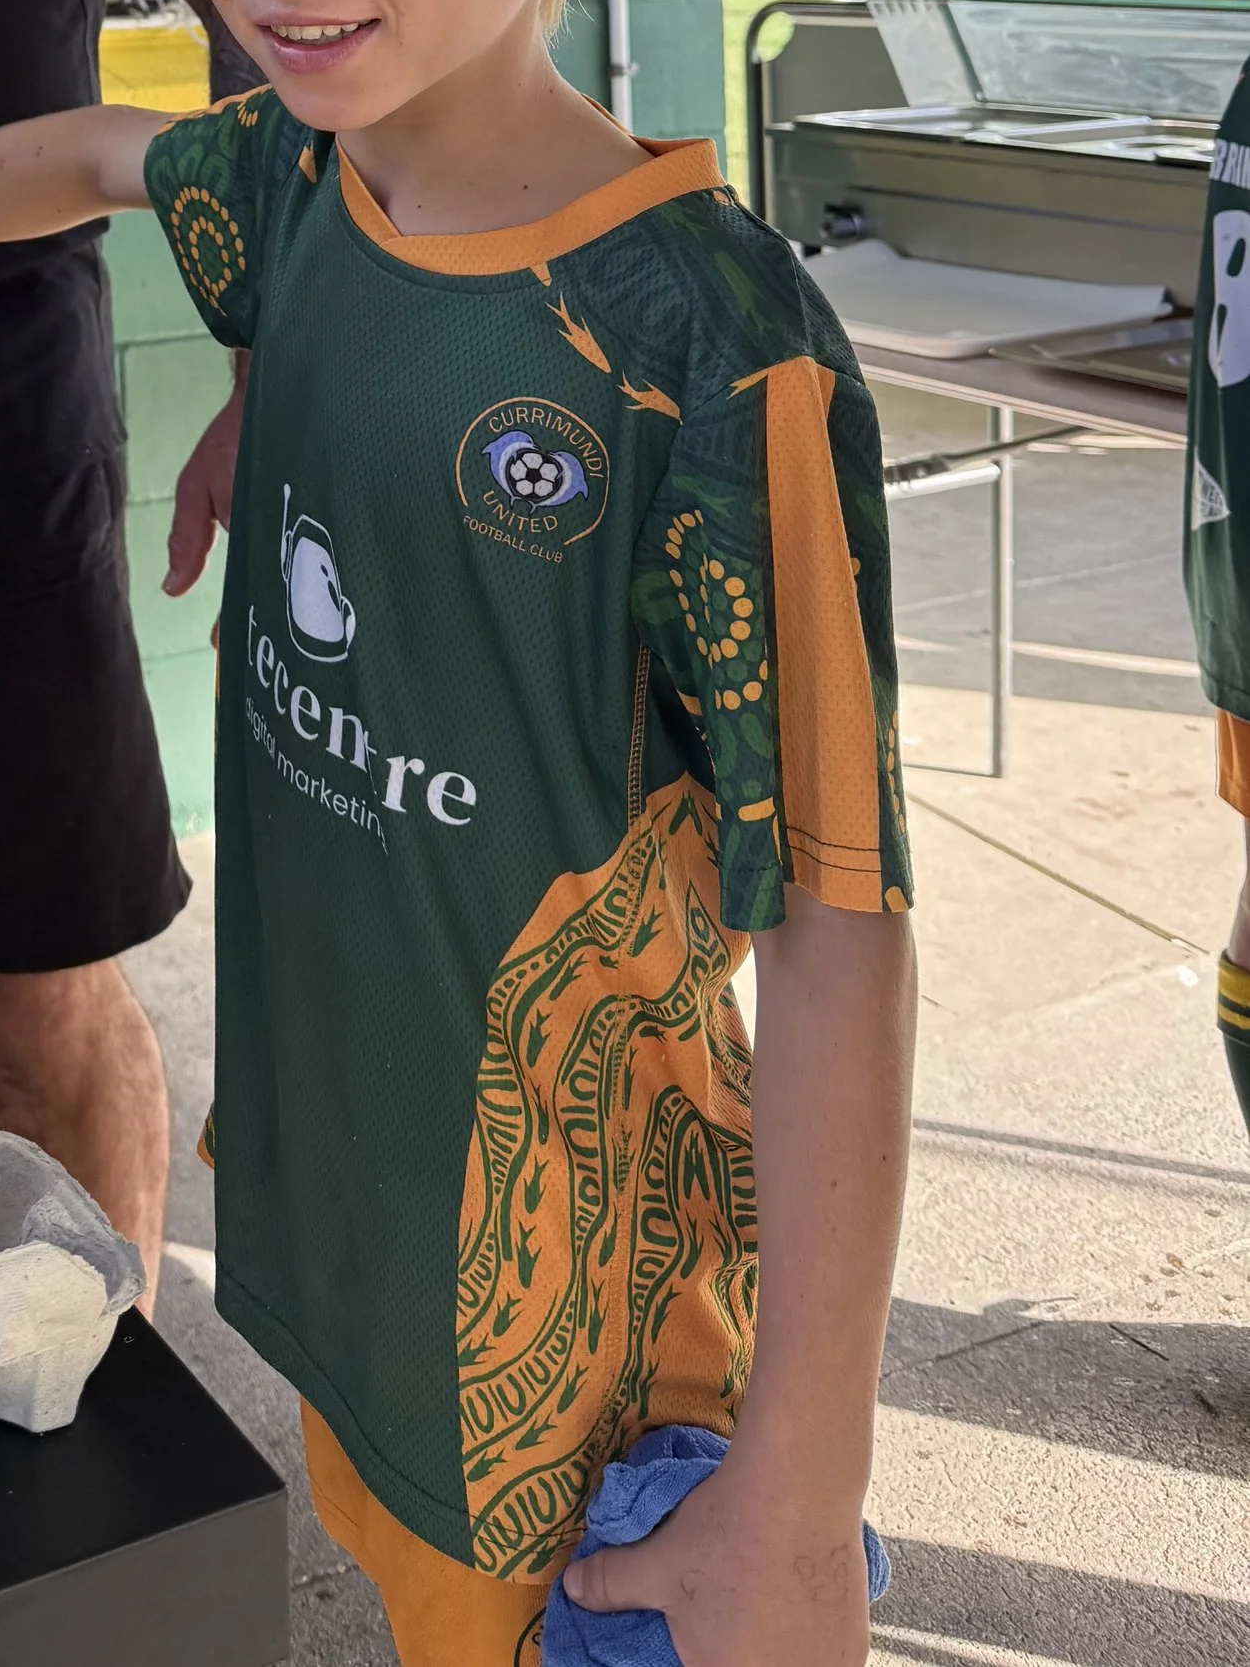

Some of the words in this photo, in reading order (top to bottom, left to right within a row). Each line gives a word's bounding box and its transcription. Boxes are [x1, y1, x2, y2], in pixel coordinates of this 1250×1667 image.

[488, 407, 604, 479] CURRIMUNDI
[463, 515, 526, 552] FOOTBALL
[530, 544, 563, 564] CLUB
[482, 490, 559, 533] UNITED
[277, 749, 388, 854] marketin
